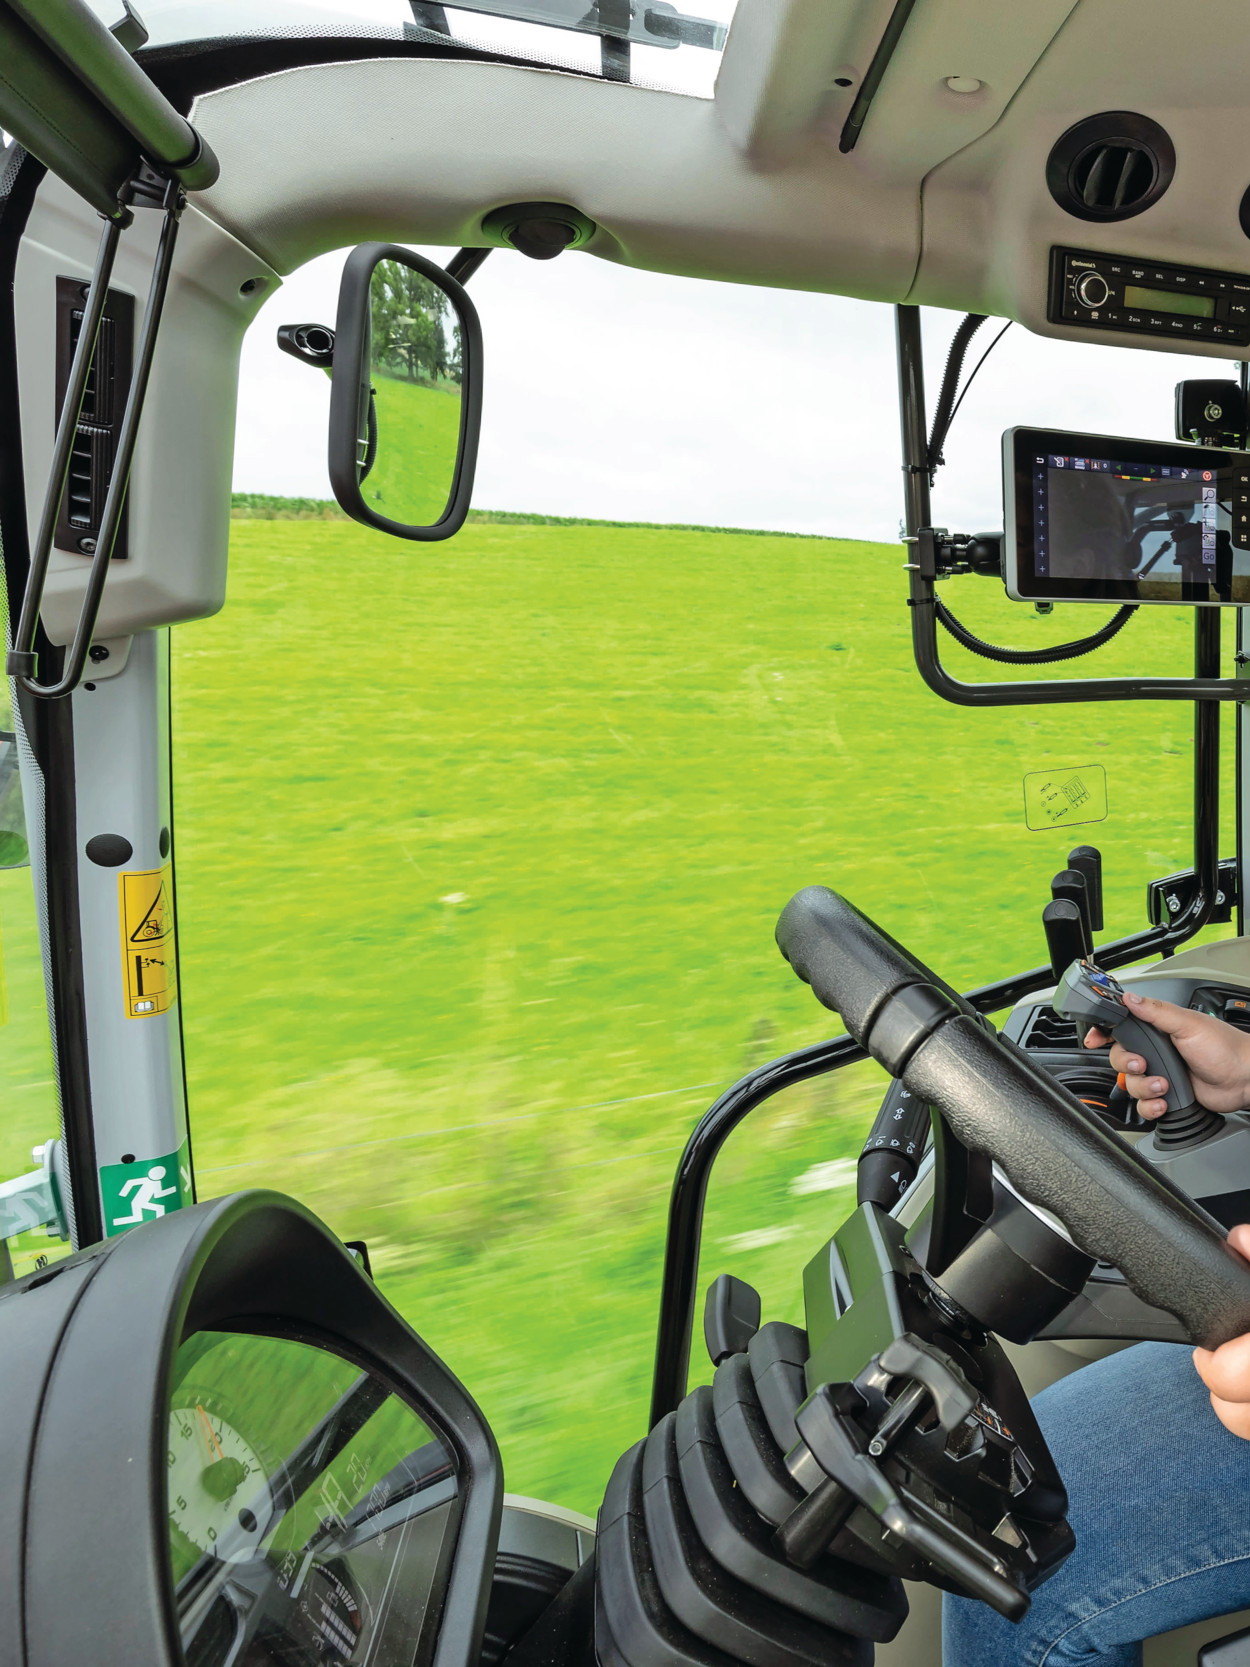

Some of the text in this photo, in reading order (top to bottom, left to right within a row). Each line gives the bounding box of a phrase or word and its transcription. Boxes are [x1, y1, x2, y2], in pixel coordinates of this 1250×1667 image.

[1203, 551, 1215, 561] Go
[181, 1423, 193, 1440] 15
[176, 1495, 187, 1511] 5
[207, 1527, 217, 1542] 0
